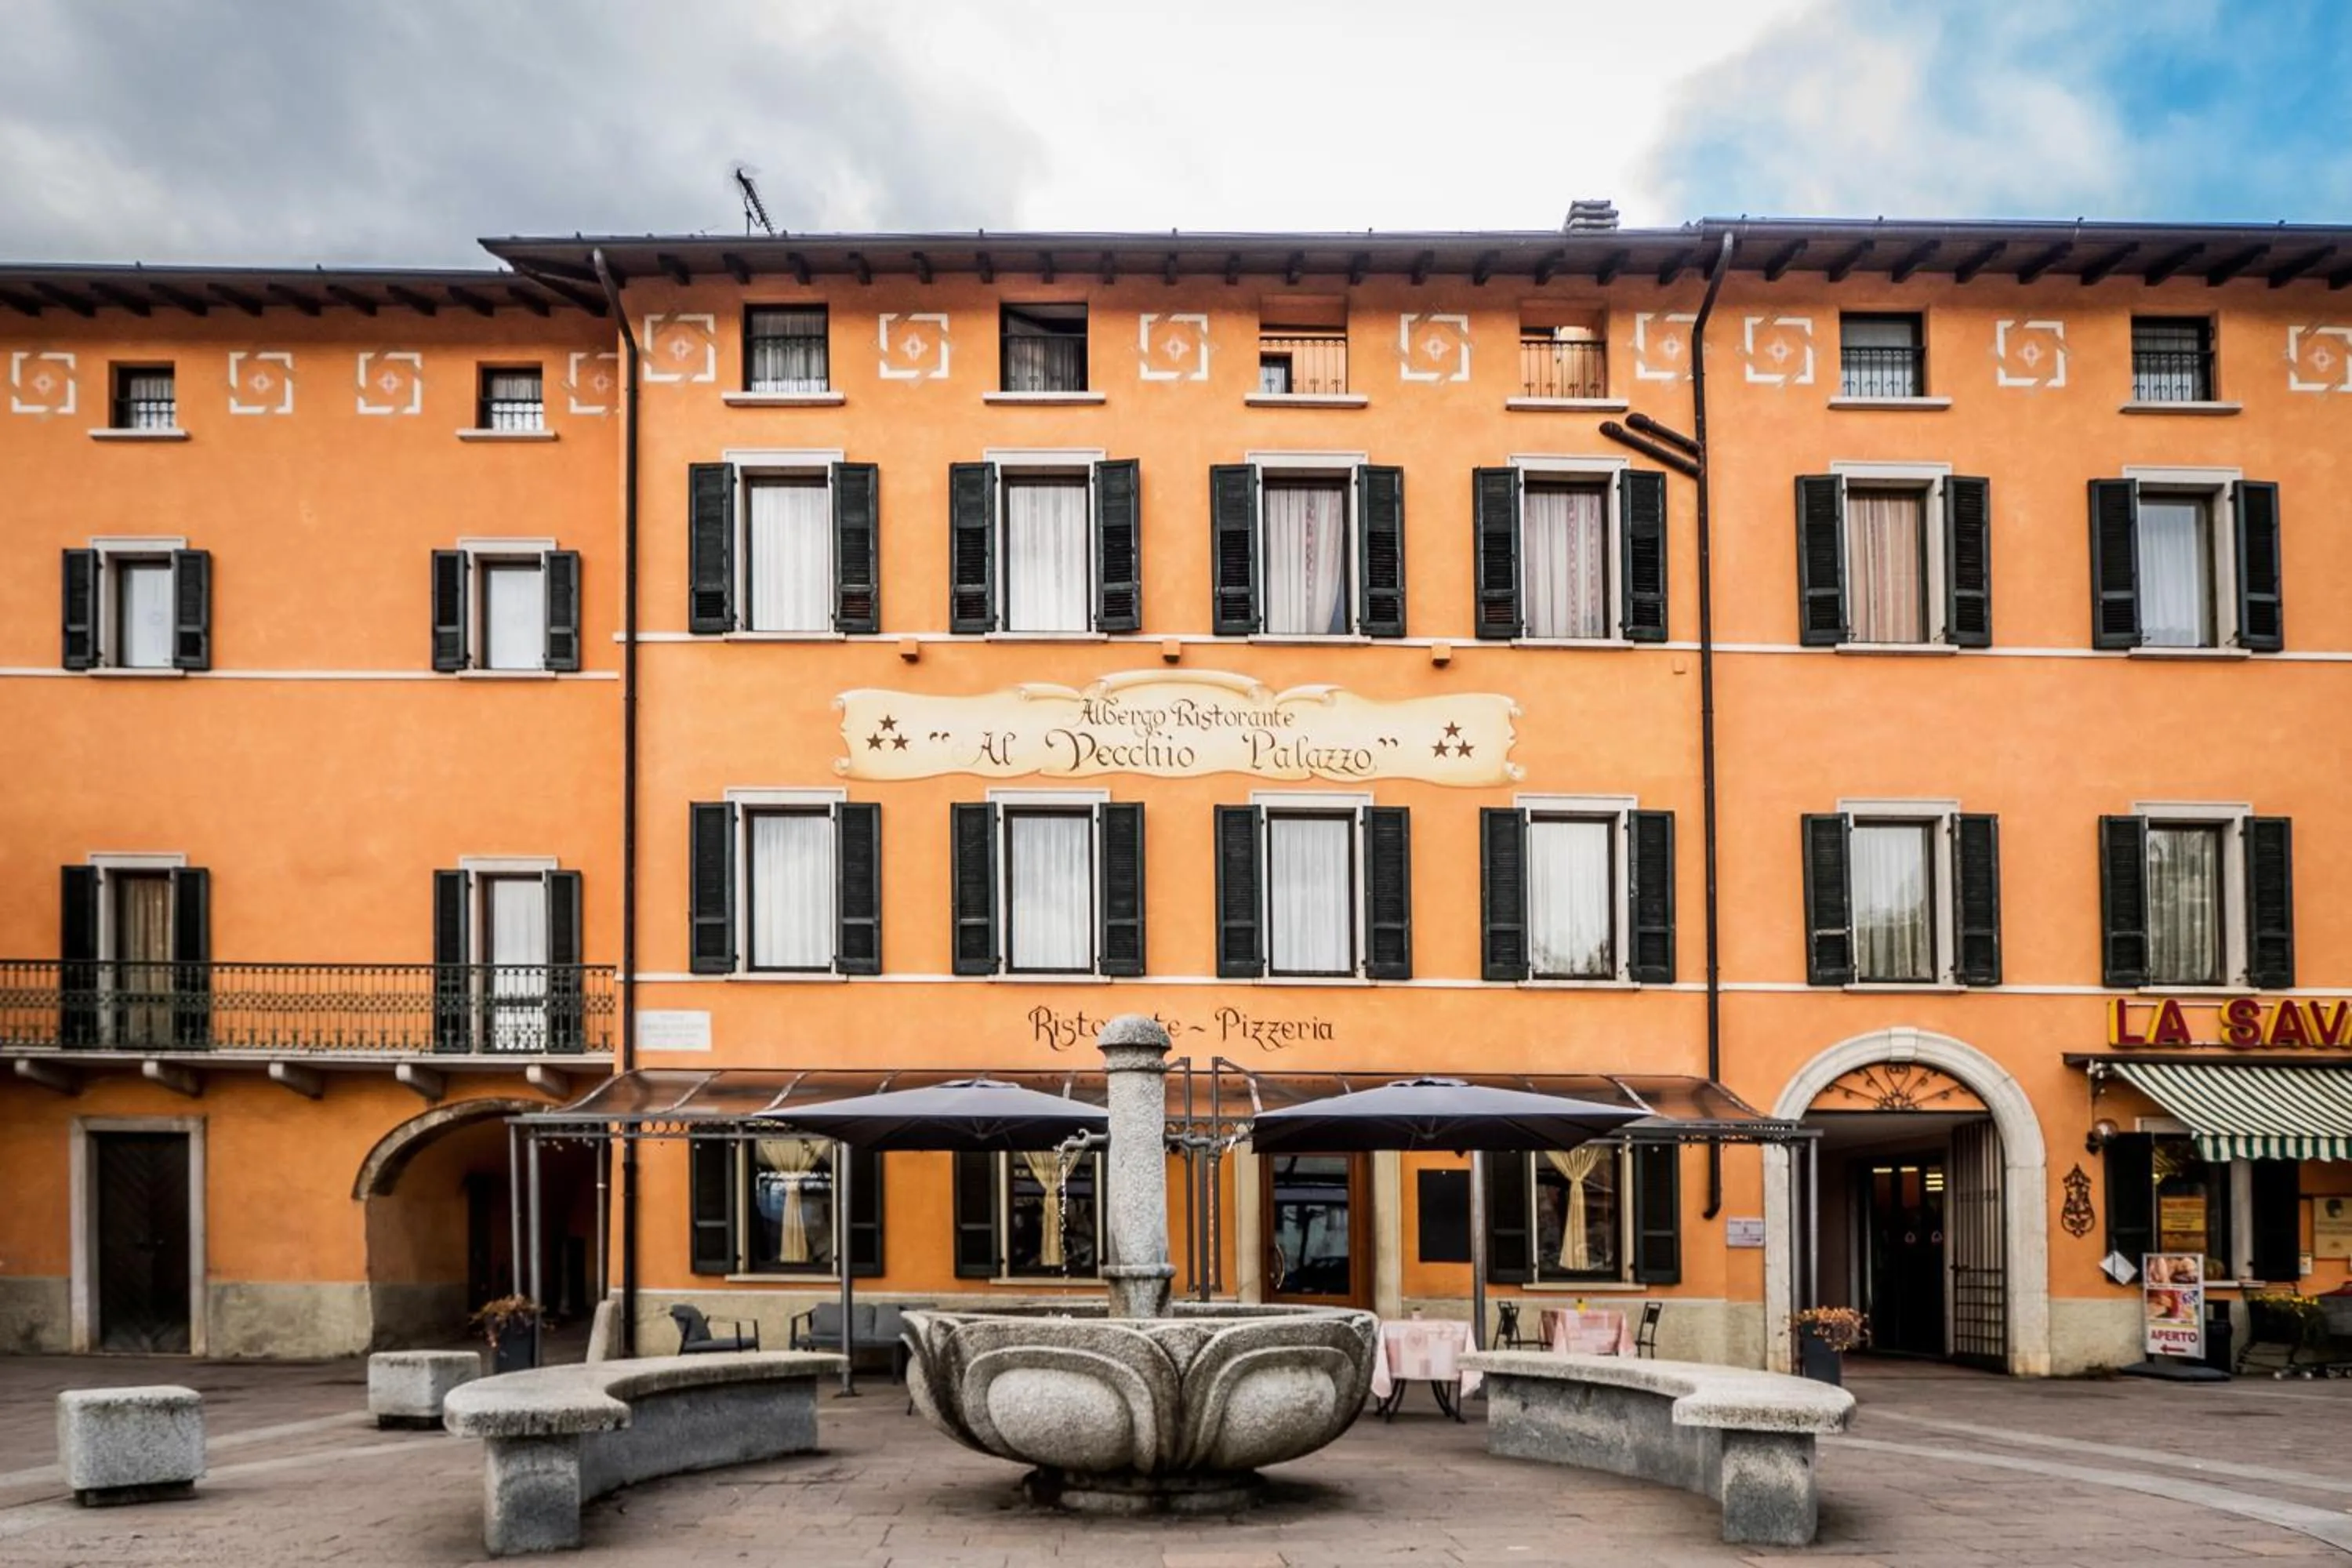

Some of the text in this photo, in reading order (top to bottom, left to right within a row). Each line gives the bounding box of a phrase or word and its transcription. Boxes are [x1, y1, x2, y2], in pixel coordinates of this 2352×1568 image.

[1067, 697, 1294, 737] Albergo Ristorante
[1045, 729, 1195, 771] Vecchio
[1028, 1005, 1181, 1052] Ristoe
[1214, 1006, 1333, 1051] Pizzeria
[2108, 998, 2352, 1049] LA SAV
[2151, 1330, 2198, 1343] APERTO
